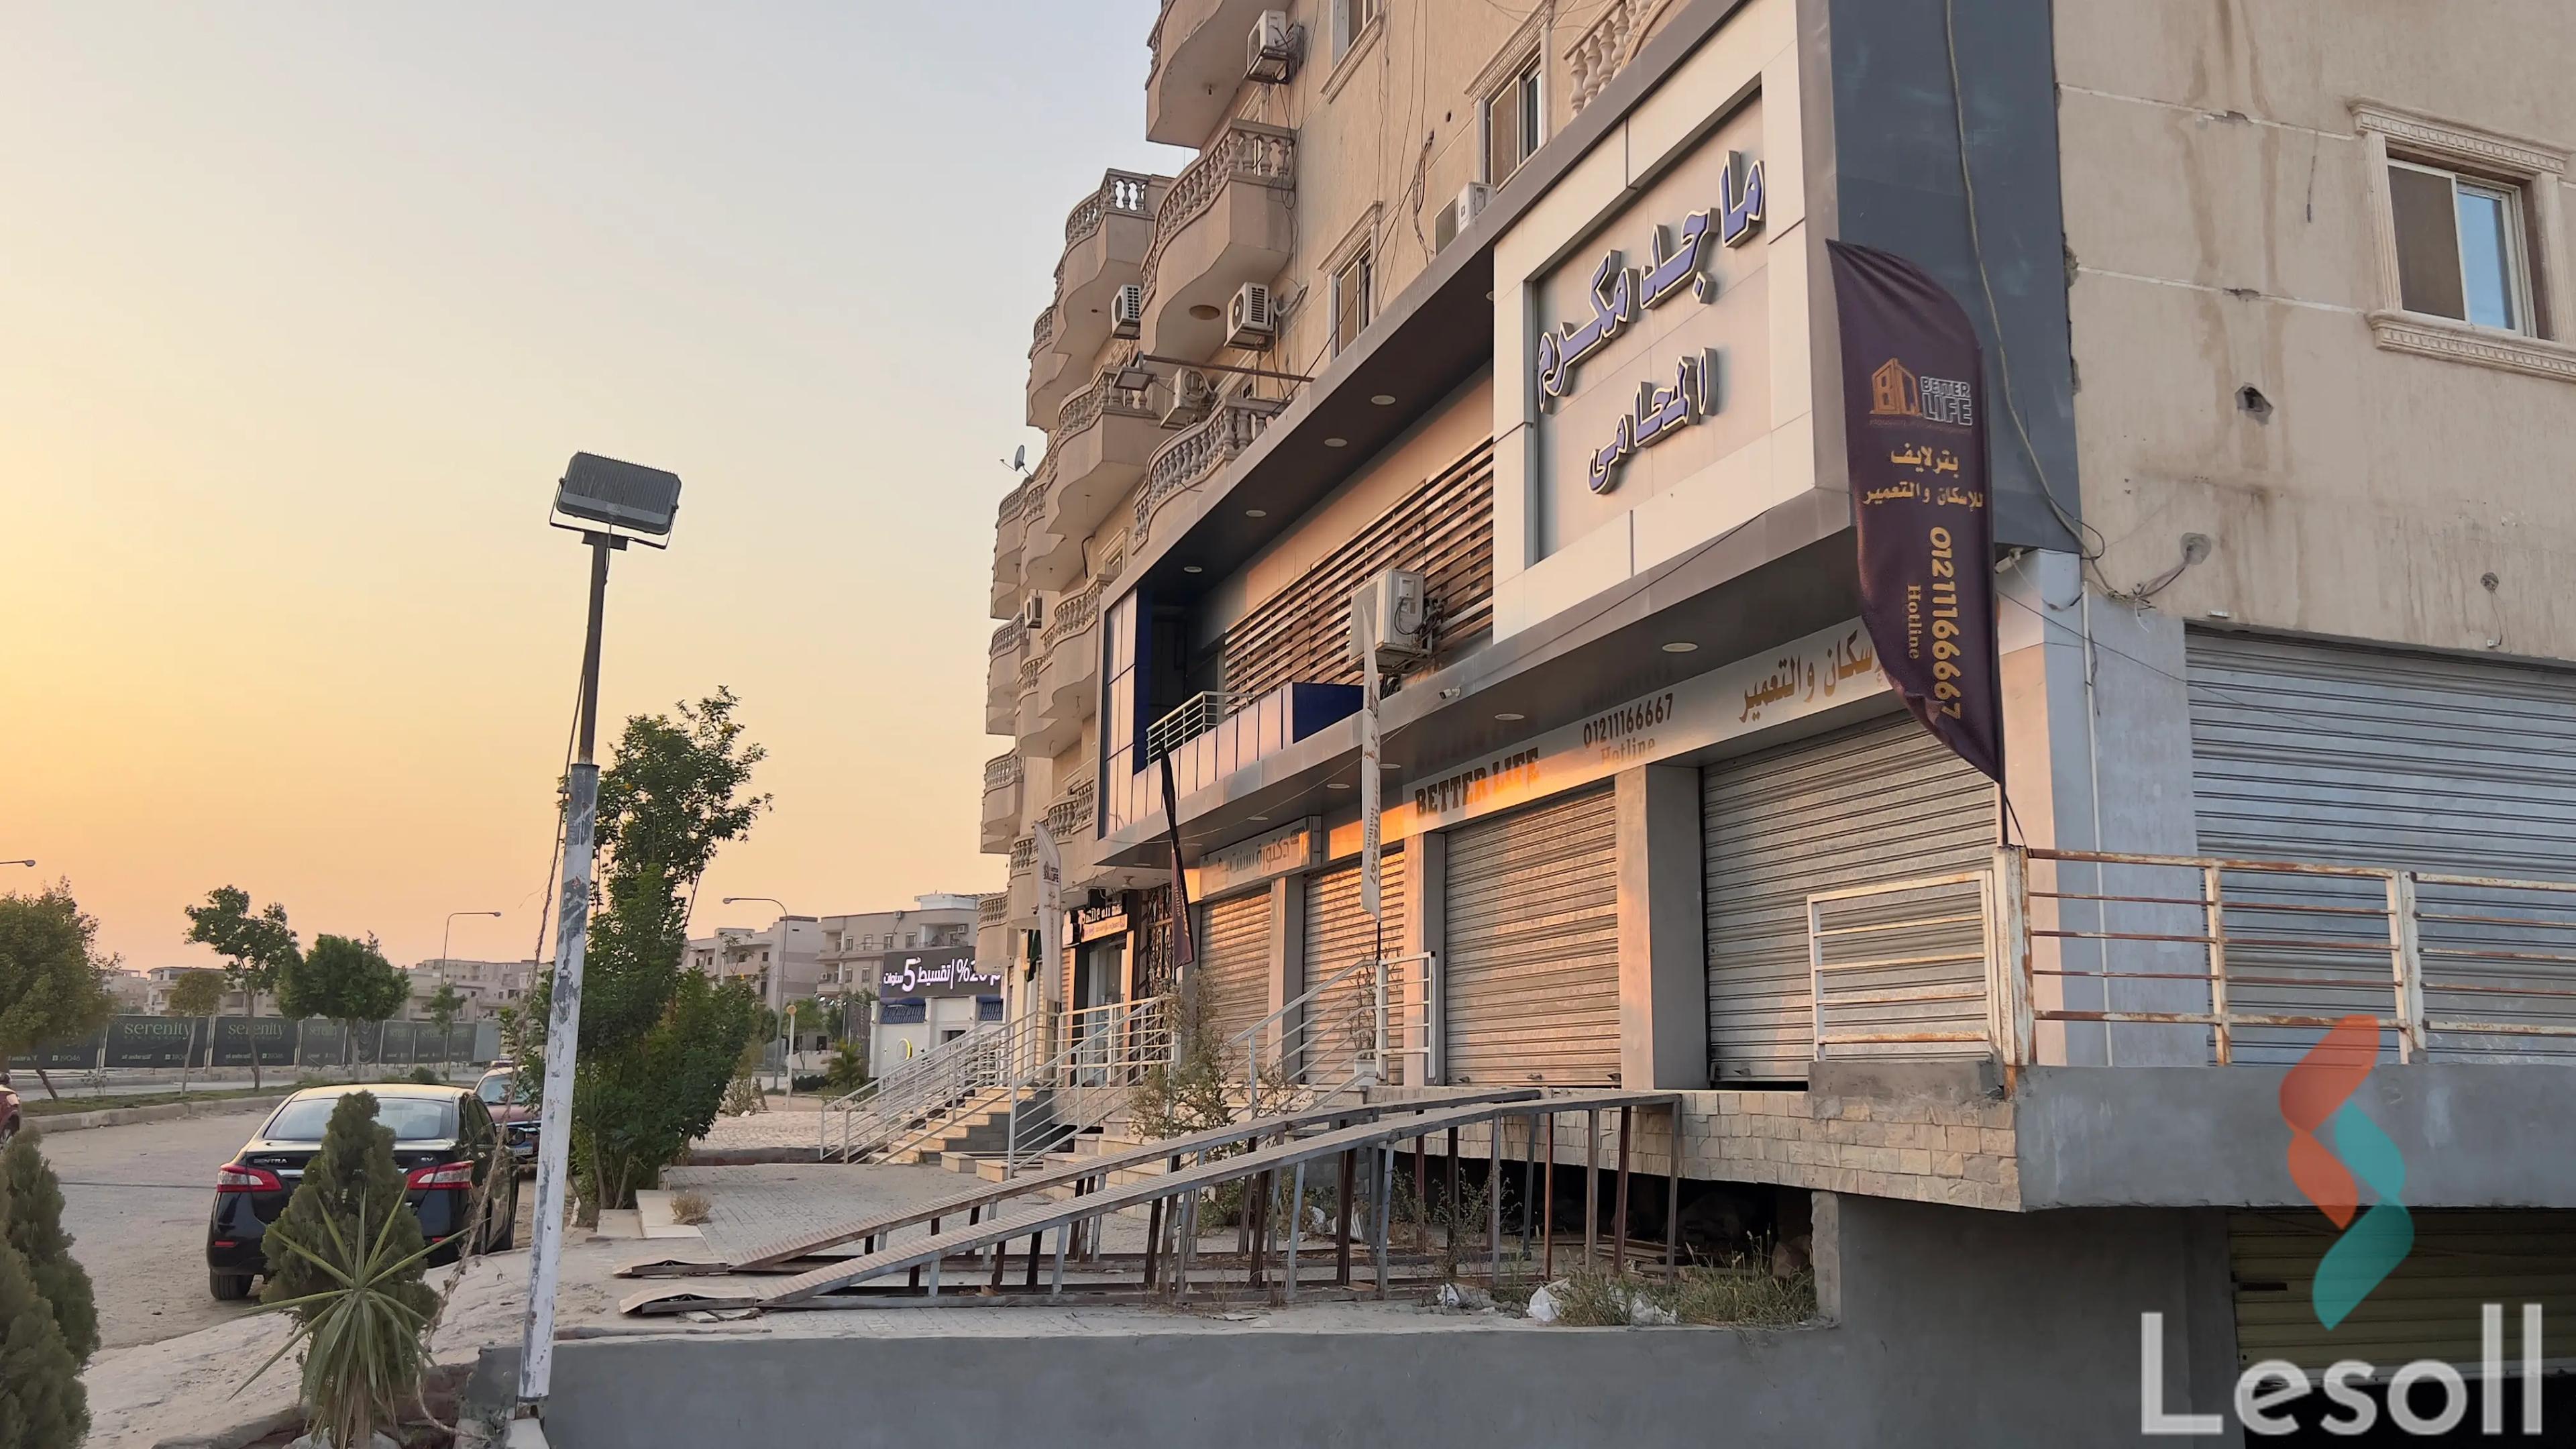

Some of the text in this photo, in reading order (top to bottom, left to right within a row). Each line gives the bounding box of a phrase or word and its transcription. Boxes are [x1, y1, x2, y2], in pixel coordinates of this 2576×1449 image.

[1537, 150, 1765, 415] ماجد مكرم
[1920, 376, 1971, 398] BETTER
[1921, 392, 1974, 426] LIFE
[1907, 585, 1923, 659] Hotline
[1929, 527, 1962, 720] 01211166667
[1583, 692, 1673, 749] 01211166667
[1601, 737, 1656, 764] Hotline
[1415, 747, 1540, 818] BETTER LIFE
[902, 957, 921, 992] 5
[124, 1022, 189, 1040] serenity
